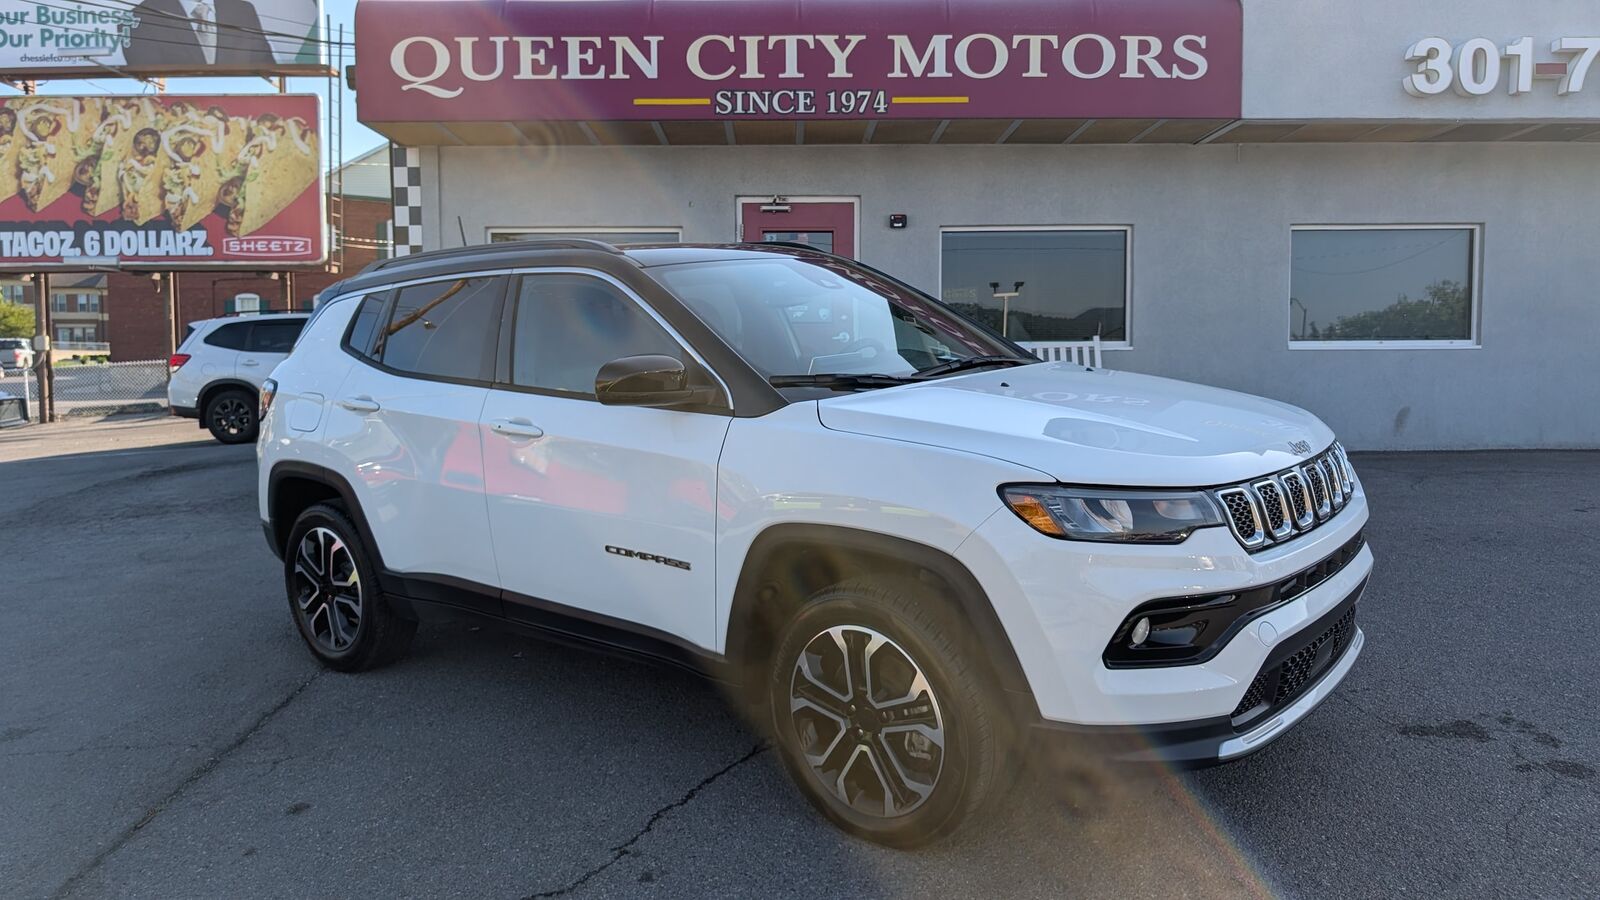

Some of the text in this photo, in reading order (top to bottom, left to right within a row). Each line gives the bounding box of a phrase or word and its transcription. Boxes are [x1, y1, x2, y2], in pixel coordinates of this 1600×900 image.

[36, 3, 140, 28] Business,
[41, 26, 131, 53] Priority!
[390, 33, 1208, 98] QUEEN CITY MOTORS
[1403, 36, 1600, 97] 301-7
[715, 90, 888, 114] SINCE 1974
[0, 230, 214, 257] TACOZ. 6 DOLLARZ.
[229, 240, 305, 252] SHEETZ
[605, 545, 691, 571] COMPASS
